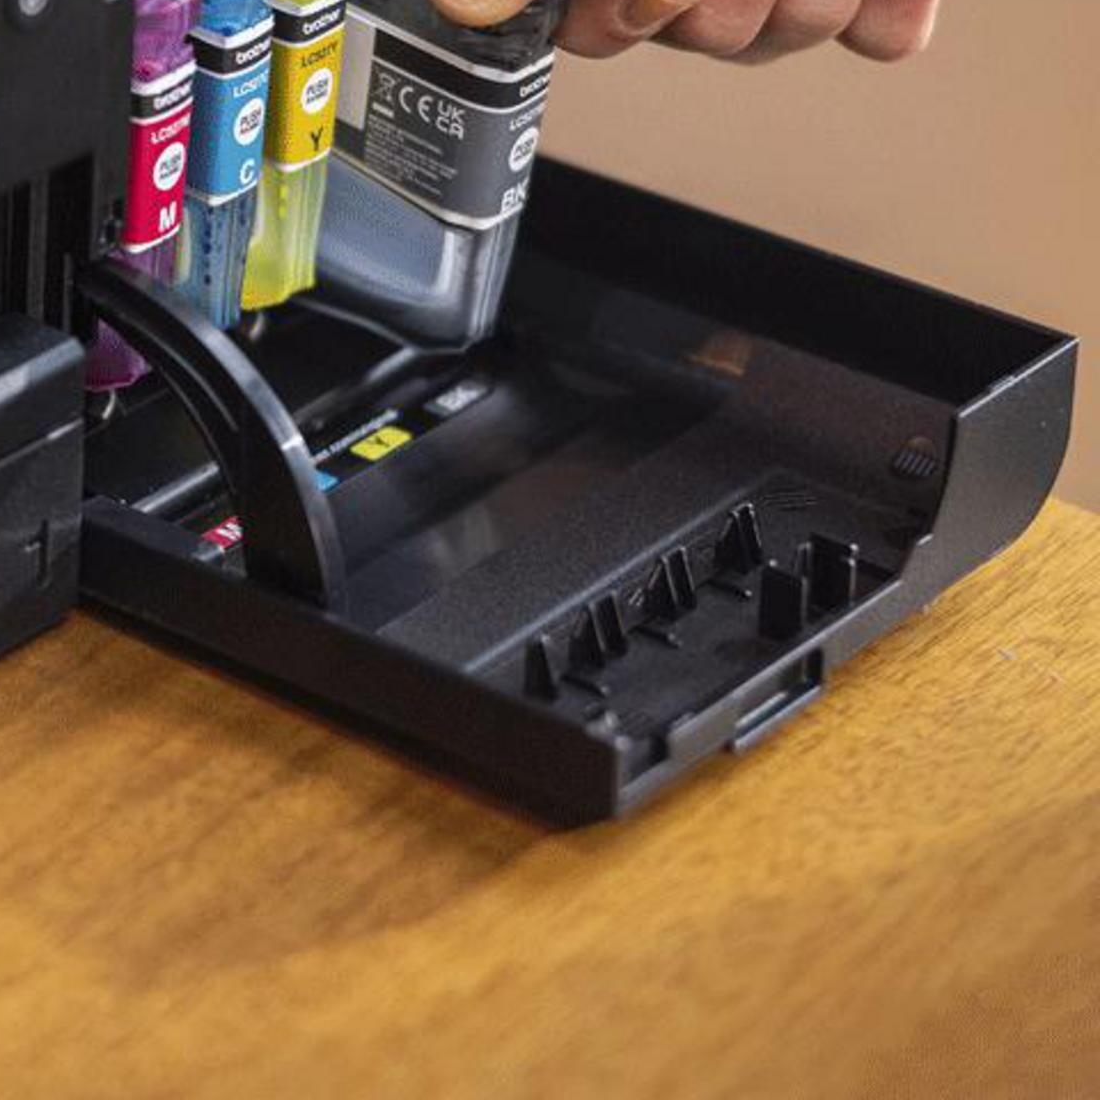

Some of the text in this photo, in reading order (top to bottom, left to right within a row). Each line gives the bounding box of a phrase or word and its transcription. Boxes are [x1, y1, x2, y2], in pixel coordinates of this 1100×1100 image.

[437, 100, 465, 125] UK
[310, 126, 324, 151] Y
[435, 115, 464, 140] CA
[240, 158, 255, 185] C
[501, 176, 529, 212] BK
[159, 201, 177, 232] M
